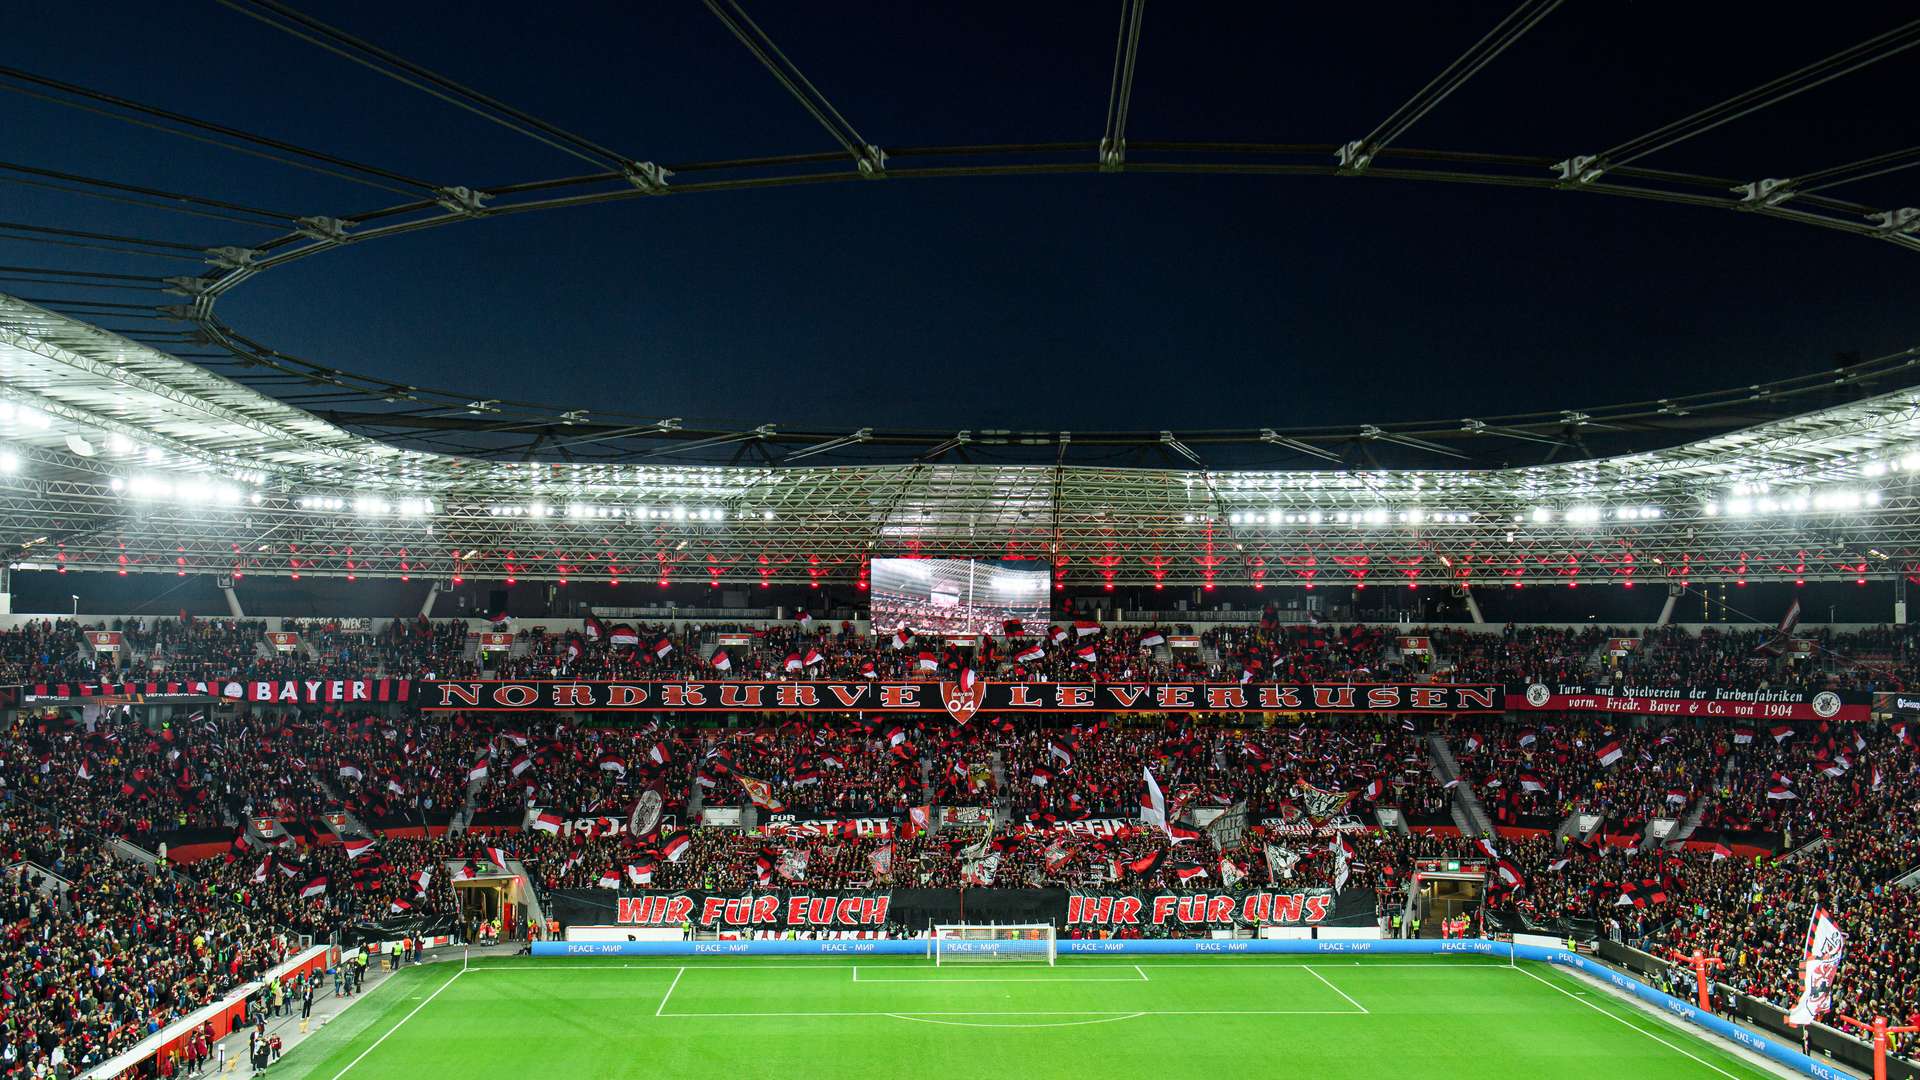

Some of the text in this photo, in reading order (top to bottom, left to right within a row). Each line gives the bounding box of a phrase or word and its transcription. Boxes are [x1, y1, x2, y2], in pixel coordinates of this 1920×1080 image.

[257, 681, 367, 700] BAYER
[438, 684, 1496, 710] NORDKURVE LEVERKUSEN
[1559, 684, 1803, 706] Turn- und Spielverein der Farbenfabriken
[948, 699, 976, 713] 04
[1568, 697, 1793, 717] vorm. Friedr. Bayer & Co. von 1904
[617, 895, 890, 925] WIR FÜR EUCH
[1067, 893, 1331, 925] IHR FÜR UNS
[568, 944, 595, 953] PEACE
[695, 944, 721, 952] PEACE
[1071, 943, 1097, 951] PEACE
[1195, 943, 1221, 951] PEACE
[1319, 943, 1344, 951] PEACE
[1441, 943, 1466, 951] PEACE
